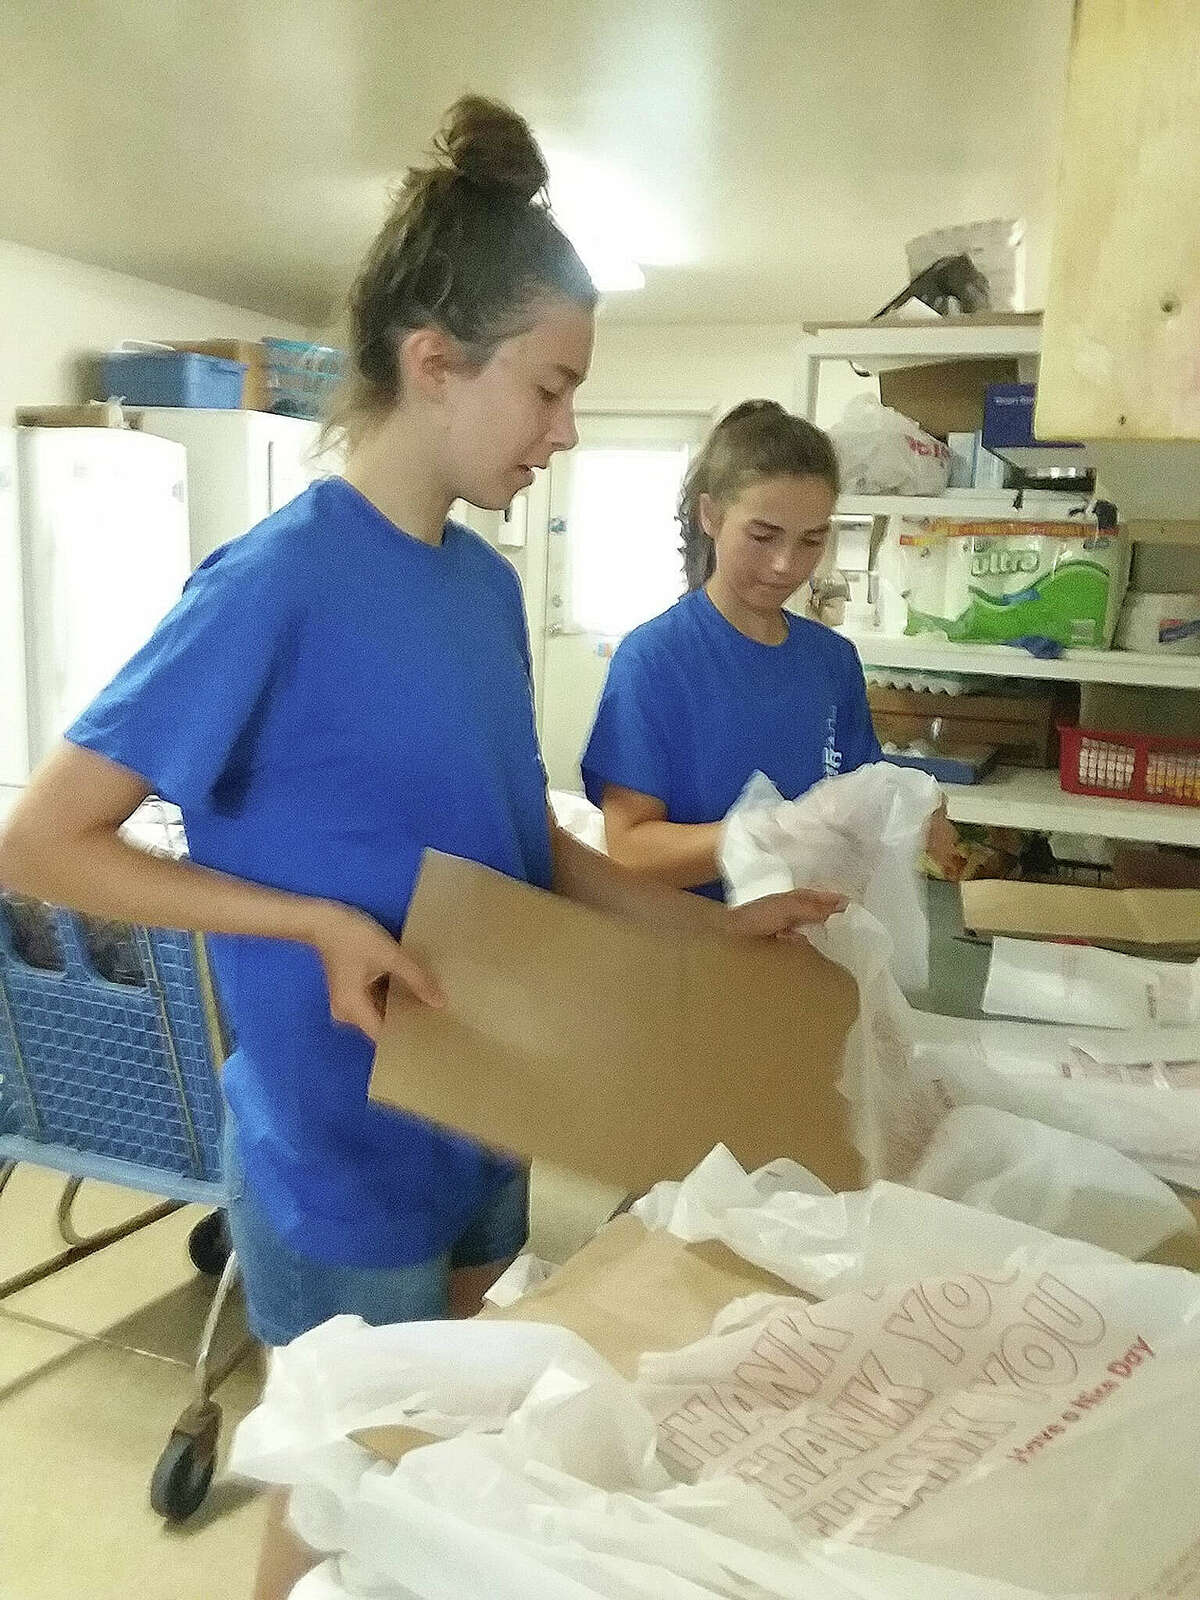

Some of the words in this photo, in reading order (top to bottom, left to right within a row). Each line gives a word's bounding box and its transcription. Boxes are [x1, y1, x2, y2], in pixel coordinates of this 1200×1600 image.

[976, 1271, 1106, 1402] YOU
[1106, 1333, 1156, 1378] Day
[733, 1349, 934, 1512] HANK
